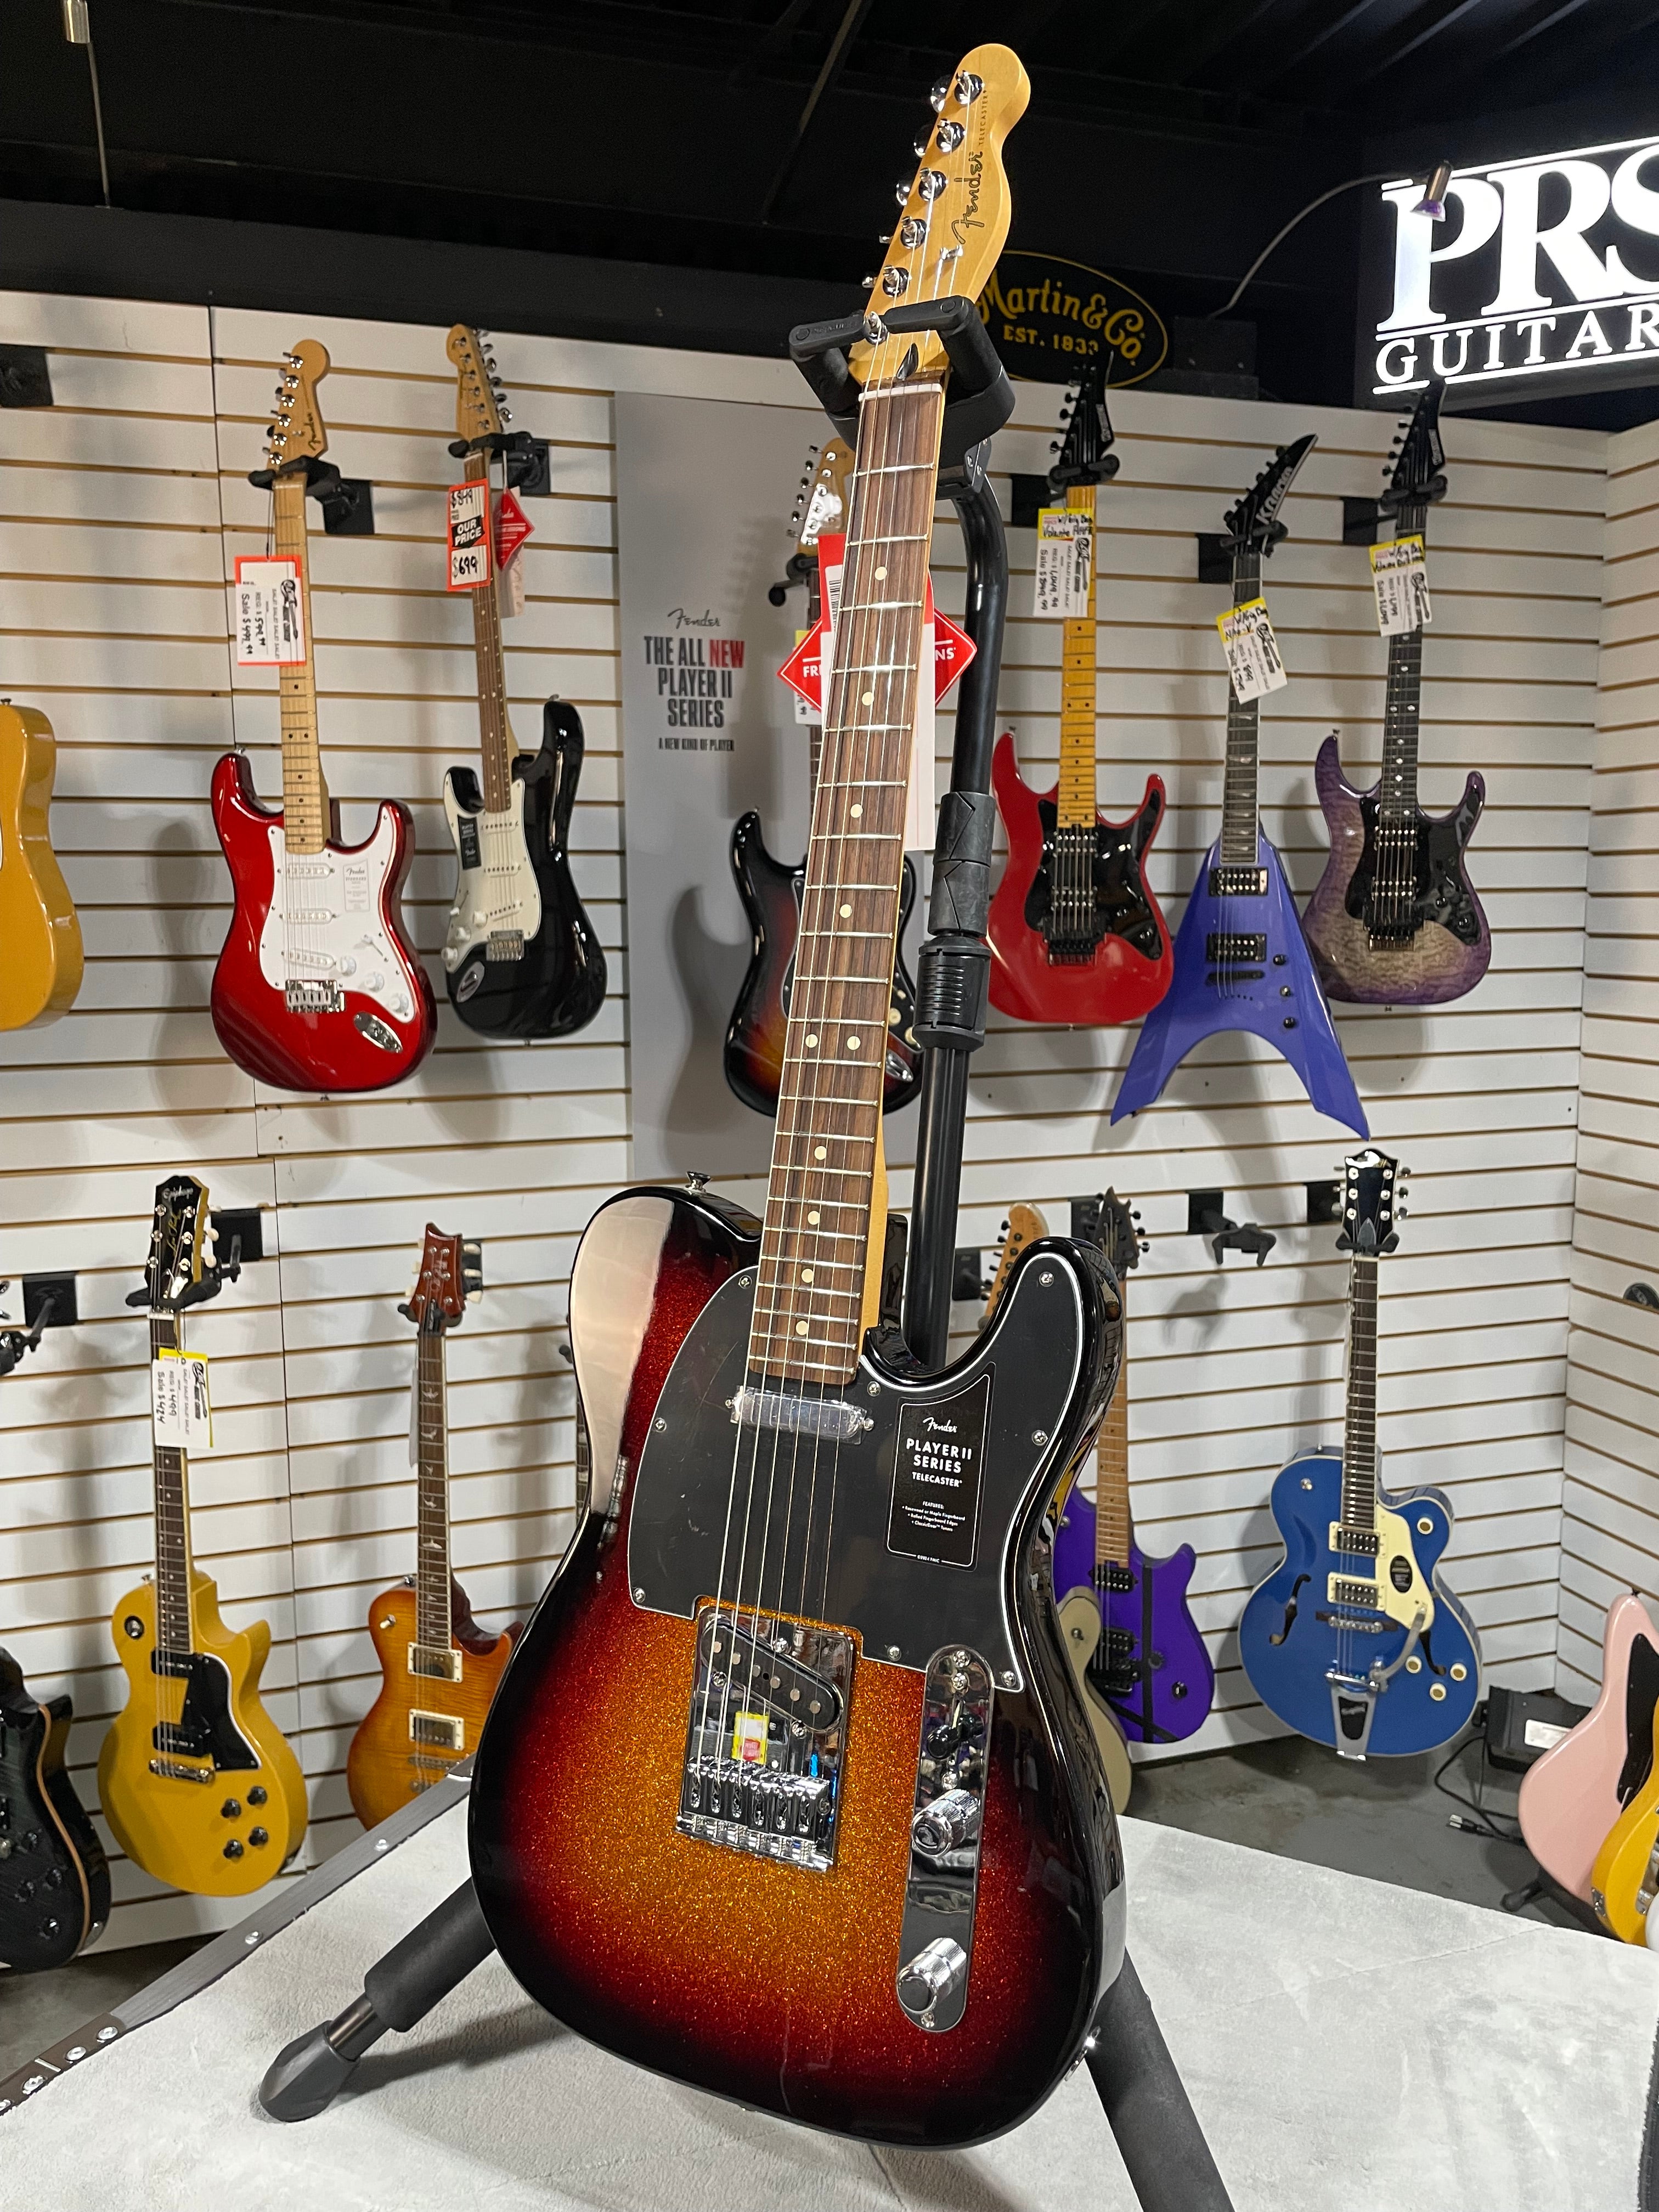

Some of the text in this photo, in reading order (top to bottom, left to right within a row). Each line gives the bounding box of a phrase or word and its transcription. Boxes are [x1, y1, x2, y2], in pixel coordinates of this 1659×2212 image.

[951, 151, 985, 245] Fender
[1003, 324, 1045, 347] EST.
[454, 526, 482, 546] PRICE
[457, 518, 477, 534] OUR
[453, 555, 477, 579] $699
[241, 593, 250, 615] Sale
[667, 608, 721, 629] Fender
[644, 636, 745, 668] THE ALL NEW
[803, 664, 821, 678] FR
[658, 668, 733, 698] PLAYER II
[668, 699, 725, 729] SERIES
[710, 739, 735, 752] PLAYER
[923, 1417, 957, 1433] Fender
[906, 1438, 972, 1460] PLAYER II
[913, 1455, 962, 1473] SERIES
